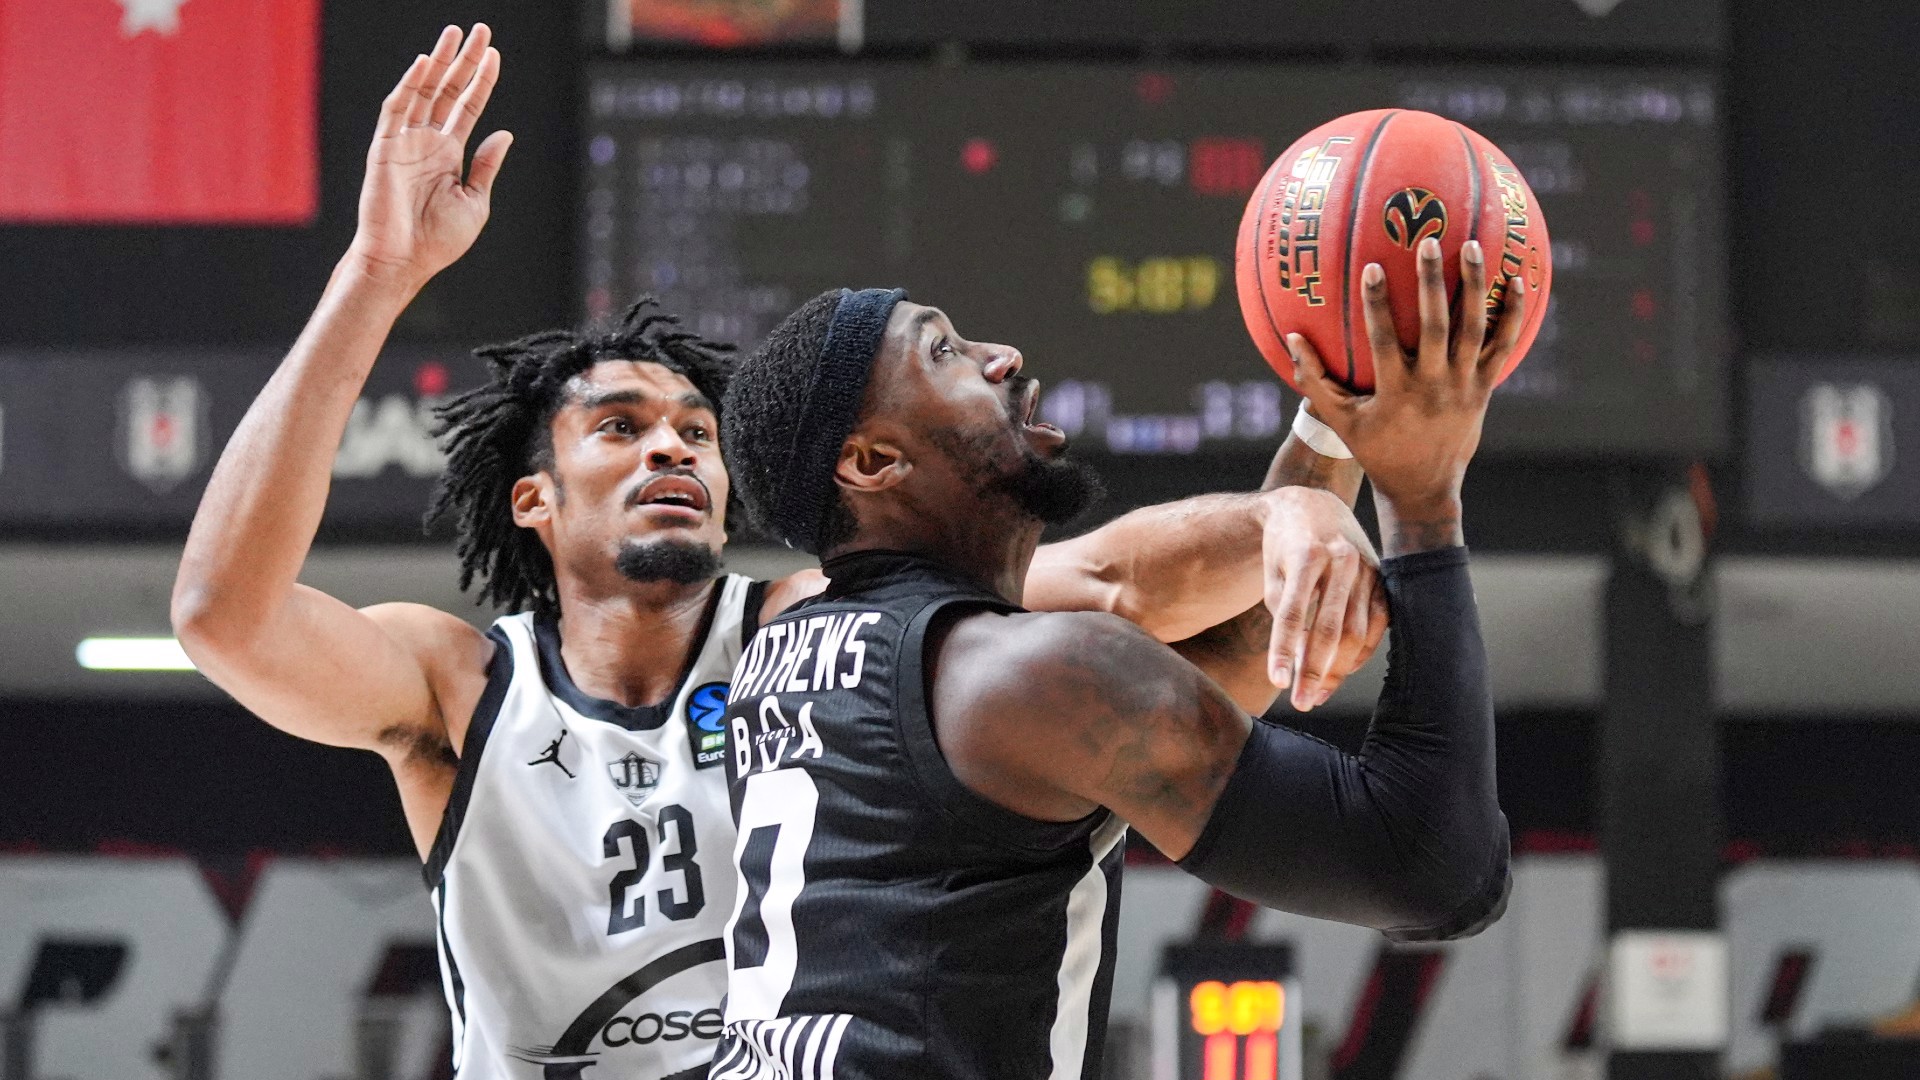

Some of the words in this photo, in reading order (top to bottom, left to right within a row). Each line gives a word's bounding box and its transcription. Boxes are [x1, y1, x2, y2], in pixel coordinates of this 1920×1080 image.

[1266, 239, 1275, 260] BALL
[1294, 136, 1355, 307] LEGACY
[728, 612, 882, 706] MATHEWS
[731, 694, 824, 779] BOA
[603, 803, 706, 936] 23
[722, 767, 819, 1022] 0
